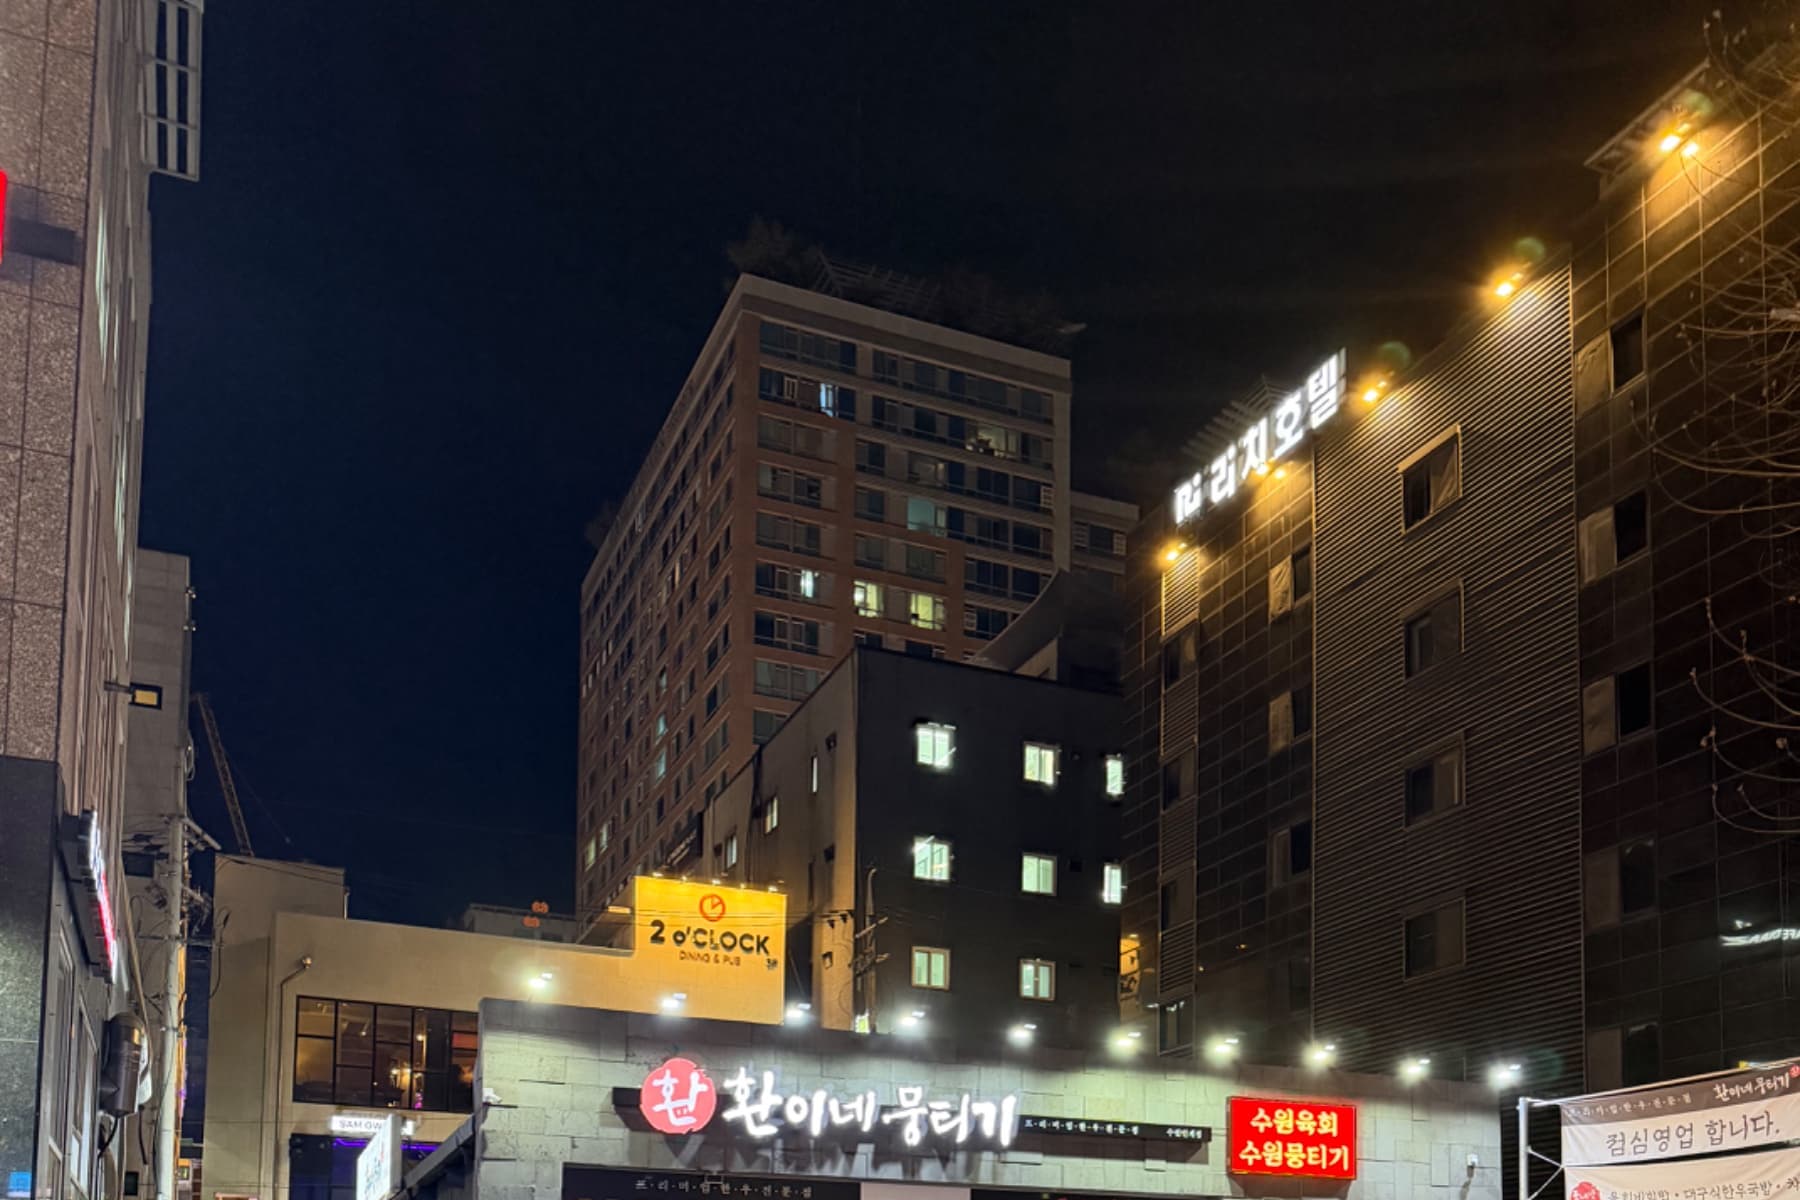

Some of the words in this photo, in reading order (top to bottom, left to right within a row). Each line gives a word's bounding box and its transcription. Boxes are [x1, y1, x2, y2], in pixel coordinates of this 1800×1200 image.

[650, 919, 665, 943] 2
[672, 926, 770, 956] o'CLOCK
[679, 950, 711, 963] DINING
[723, 955, 741, 967] PUB
[650, 1068, 708, 1127] 환
[1250, 1107, 1338, 1137] 수원육회
[1606, 1122, 1694, 1157] 점심영업
[1705, 1111, 1780, 1146] 합니다.
[1239, 1140, 1349, 1171] 수원뭉티기
